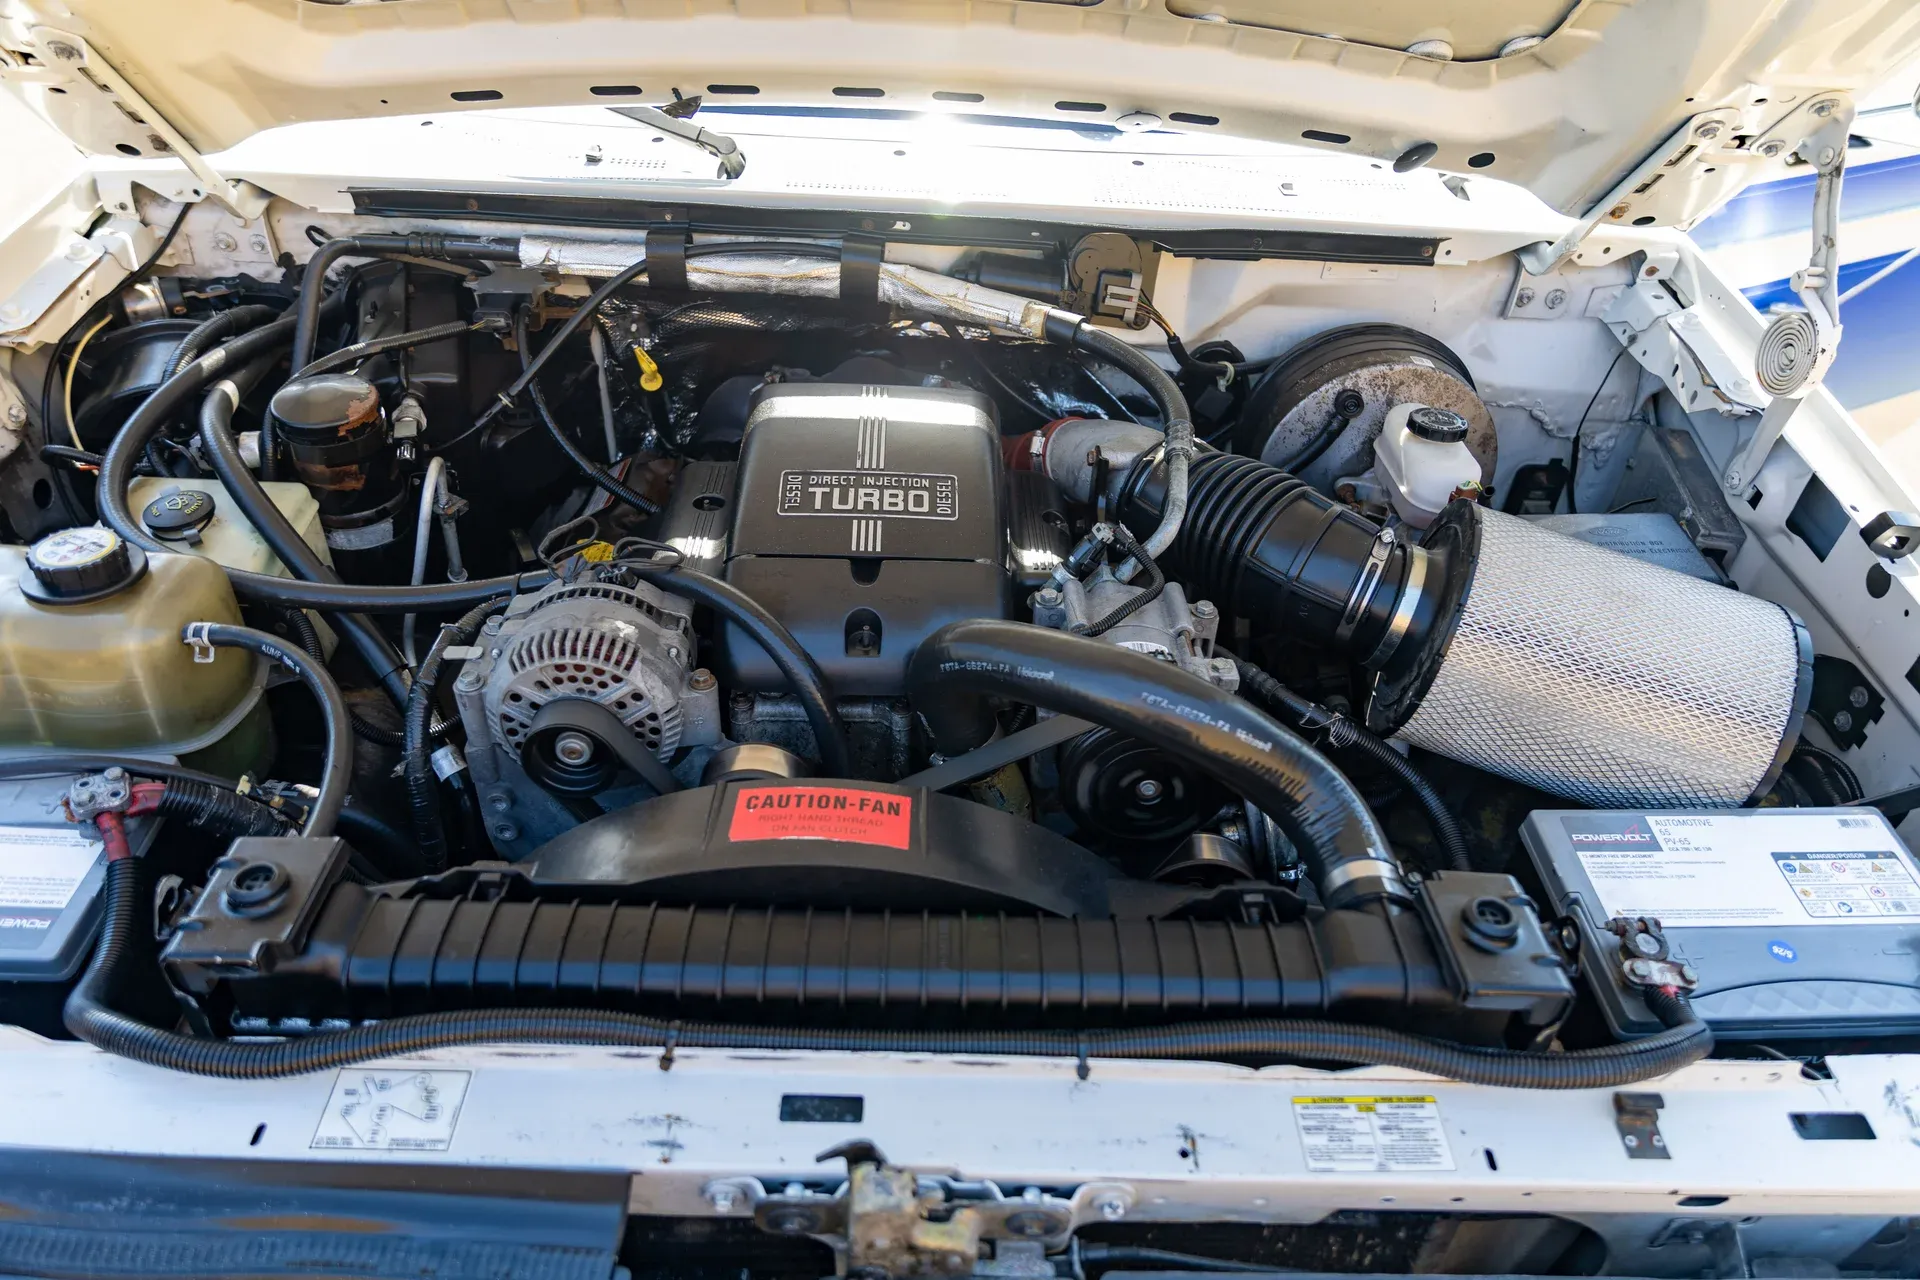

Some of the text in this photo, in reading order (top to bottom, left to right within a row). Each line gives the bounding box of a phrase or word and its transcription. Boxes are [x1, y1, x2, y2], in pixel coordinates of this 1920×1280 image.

[809, 475, 930, 488] DIRECT INJECTION
[785, 475, 802, 509] DIESEL
[936, 480, 951, 514] DIESEL
[808, 487, 930, 513] TURBO
[745, 794, 901, 816] CAUTION-FAN
[758, 813, 883, 828] RIGHT HAND THREAD
[1654, 818, 1713, 827] AUTOMOTIVE
[771, 824, 867, 835] ON FAN CLUTCH
[1658, 828, 1671, 836] 65
[1571, 833, 1652, 842] POWERVOLT
[1663, 837, 1691, 846] PV-65
